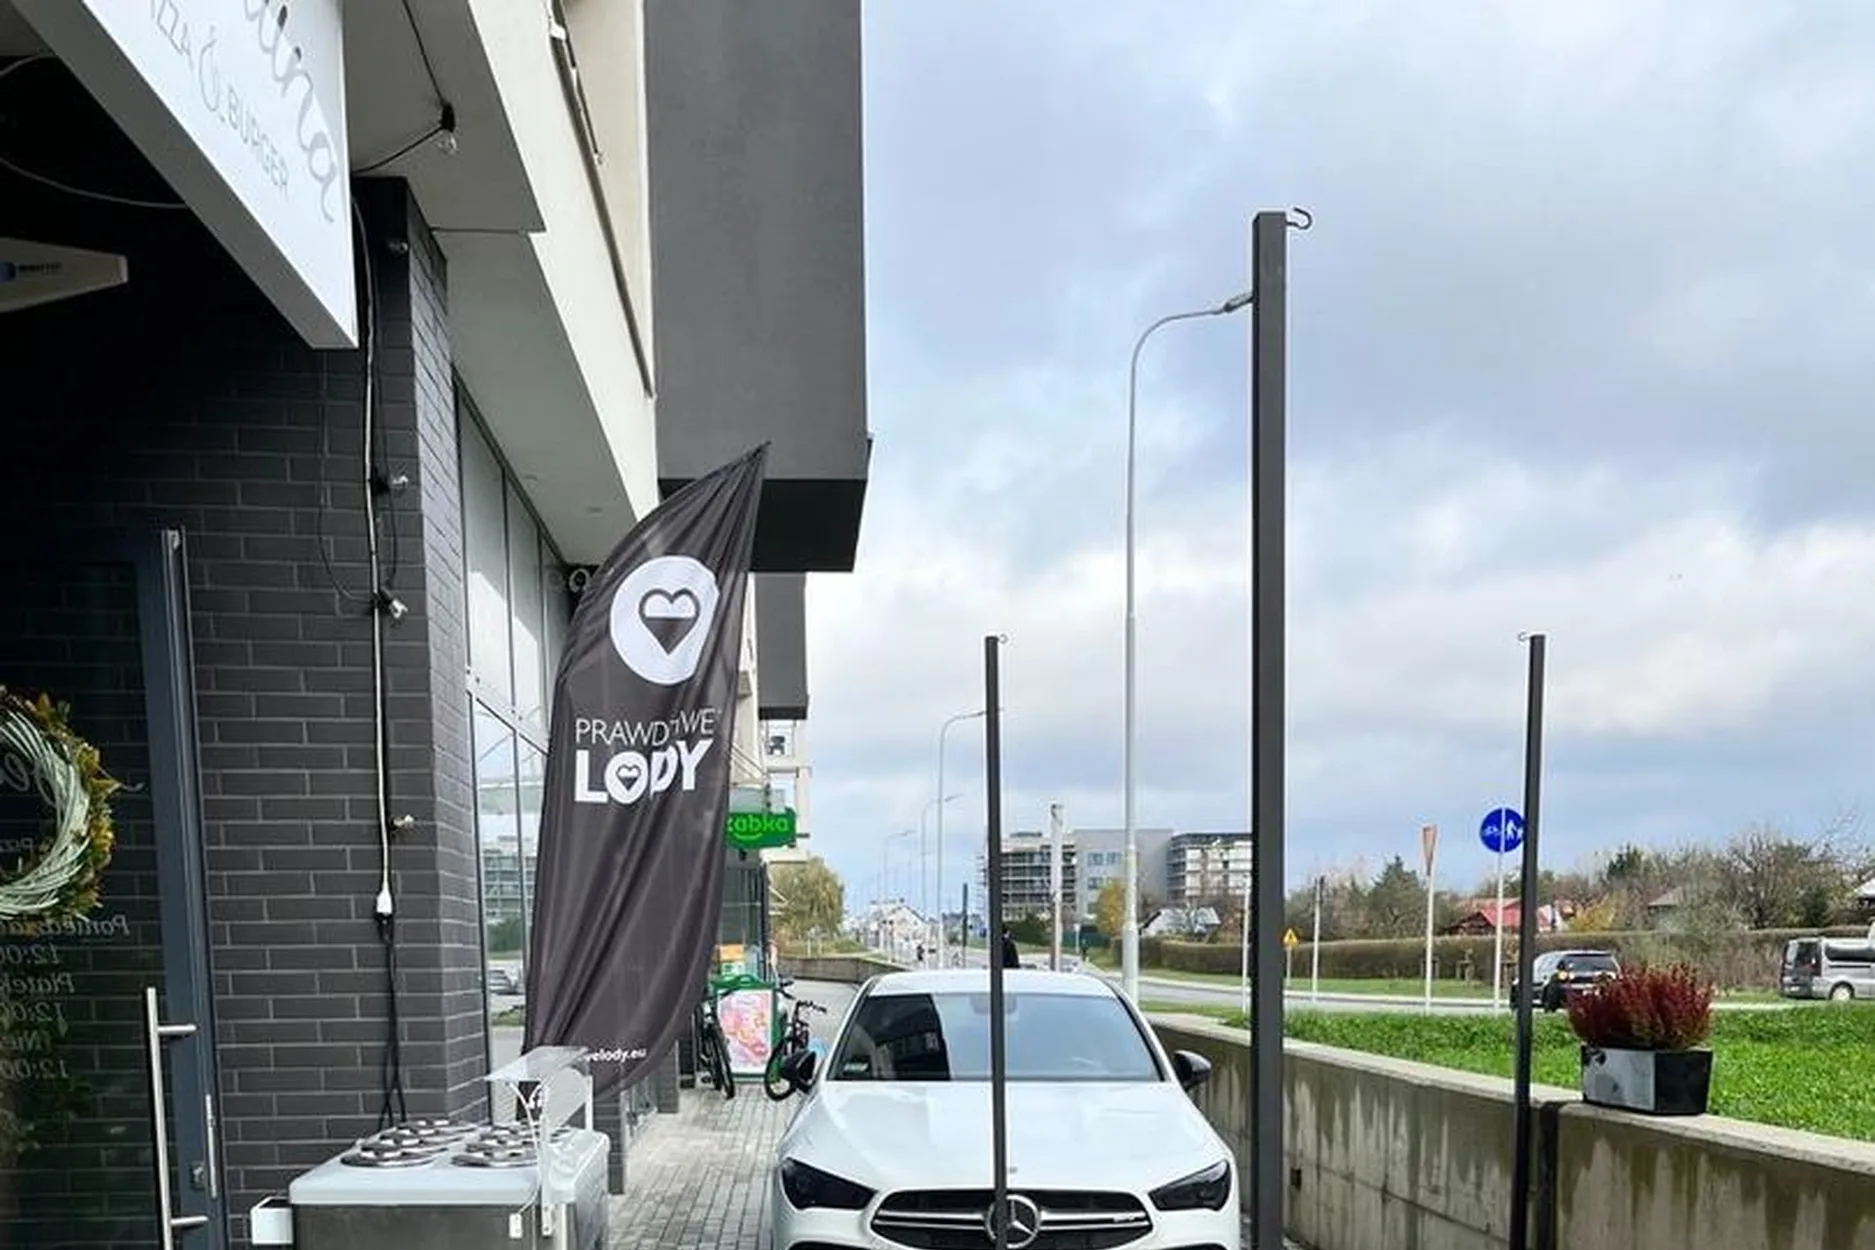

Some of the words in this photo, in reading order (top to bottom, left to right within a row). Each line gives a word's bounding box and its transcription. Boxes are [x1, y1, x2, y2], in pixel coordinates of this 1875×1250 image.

[228, 84, 289, 203] BURGER
[574, 707, 717, 747] PRAWDIWE
[574, 738, 715, 805] LODY
